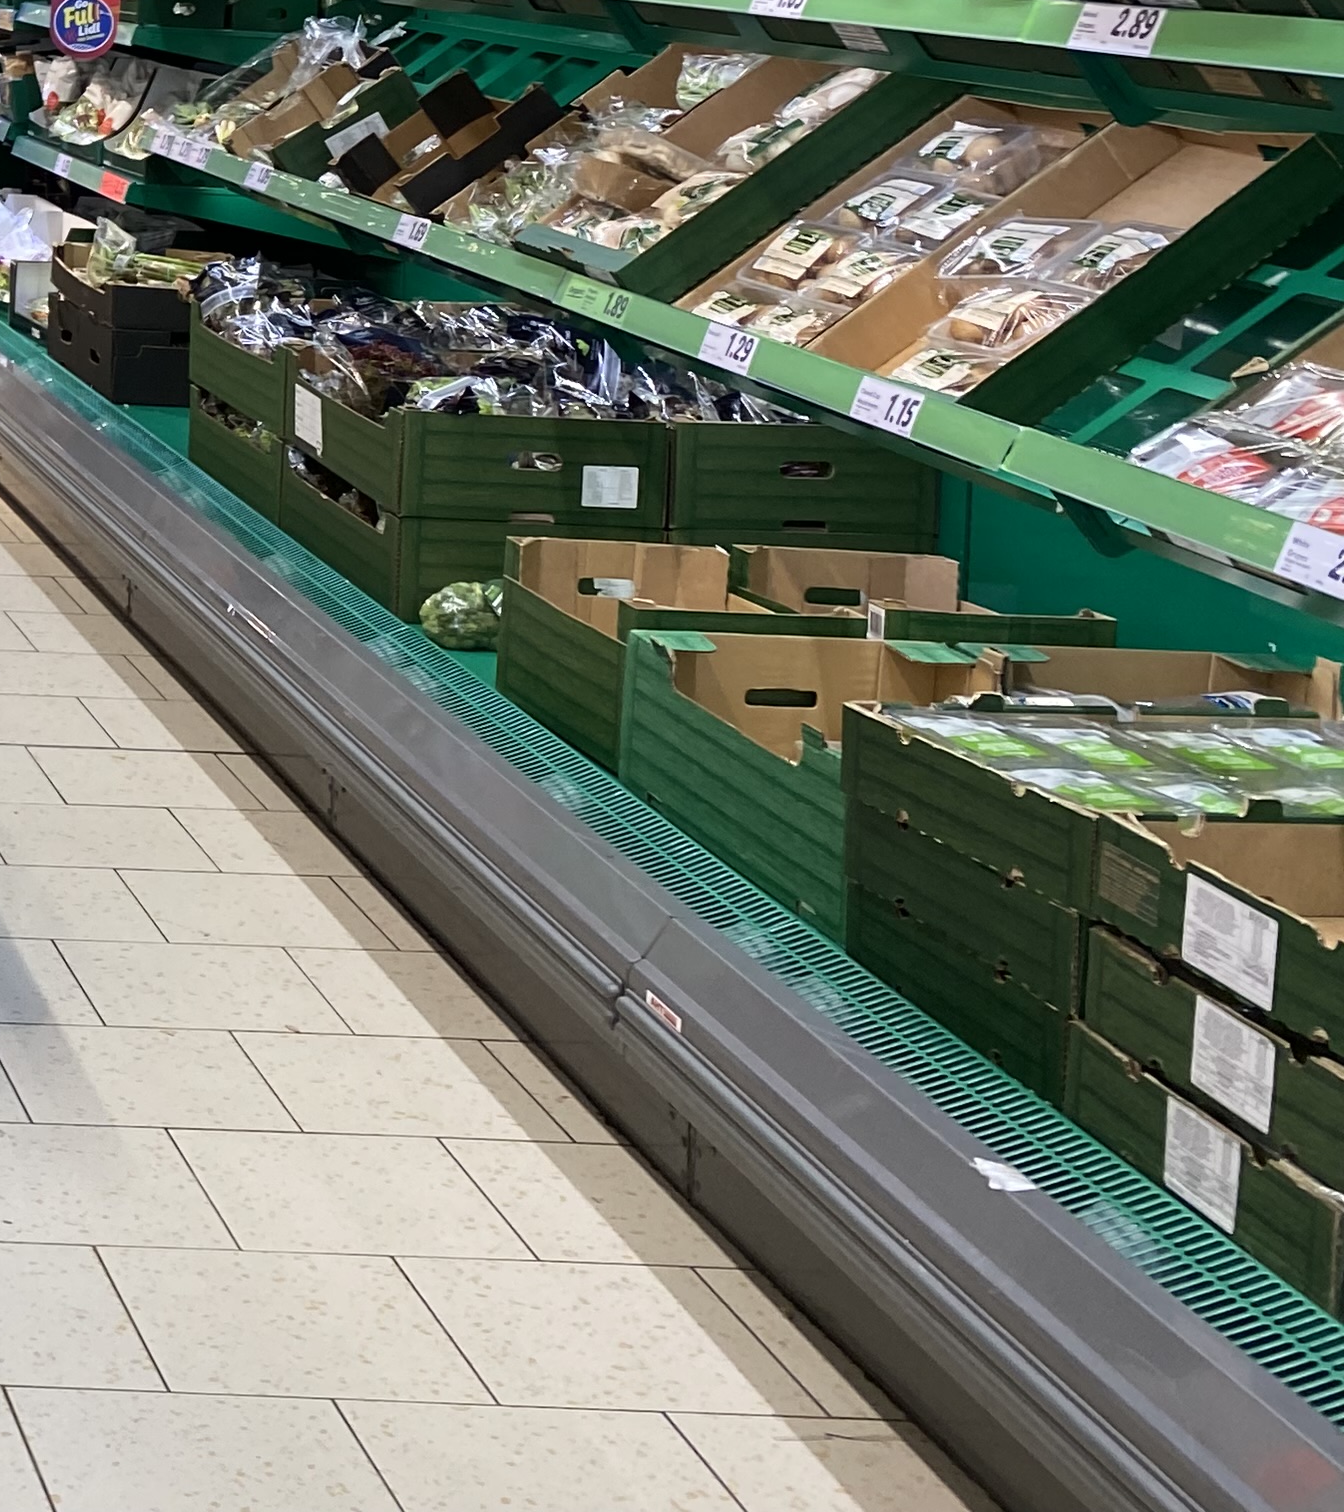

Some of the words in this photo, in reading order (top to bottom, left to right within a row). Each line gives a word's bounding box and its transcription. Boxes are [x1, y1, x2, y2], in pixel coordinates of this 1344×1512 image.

[63, 2, 100, 29] Full
[74, 0, 89, 9] Go
[78, 22, 101, 37] Lidl
[1111, 7, 1161, 40] 2.89
[603, 291, 630, 319] 1.89
[724, 332, 755, 363] 1.29
[884, 393, 921, 428] 1.15
